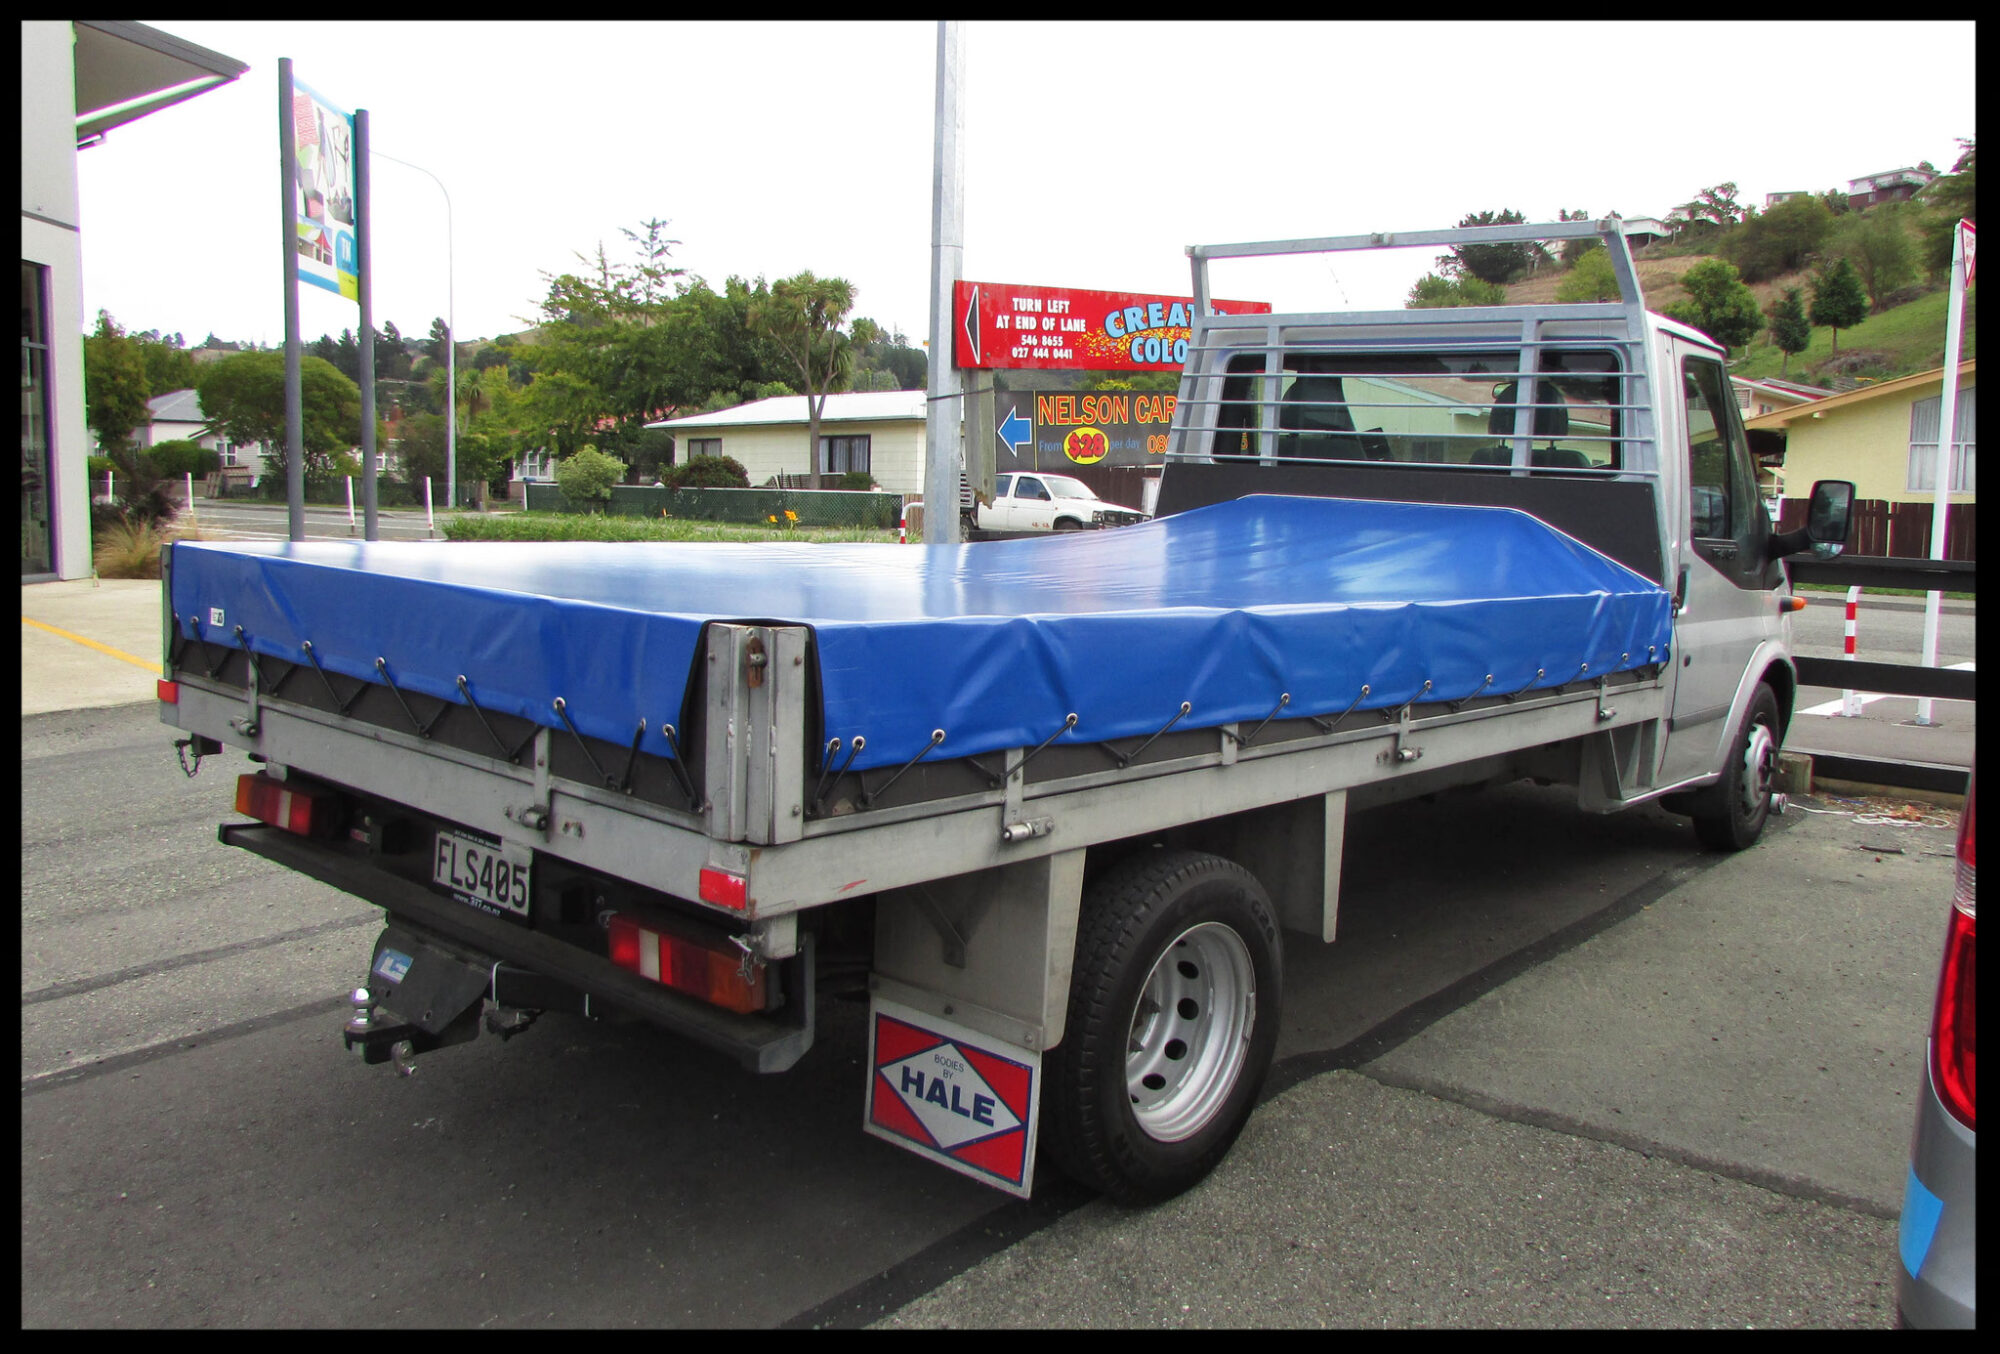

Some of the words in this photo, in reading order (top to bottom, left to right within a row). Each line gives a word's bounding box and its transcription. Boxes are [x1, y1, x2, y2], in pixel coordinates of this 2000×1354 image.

[1012, 297, 1042, 313] TURN
[1047, 299, 1070, 314] LEFT
[996, 314, 1010, 329] AT
[1015, 315, 1037, 330] END
[1042, 317, 1056, 331] OF
[1060, 318, 1086, 332] LANE
[1104, 302, 1228, 338] CREA
[1021, 334, 1038, 346] 546
[1041, 335, 1064, 347] 8655
[1130, 336, 1189, 364] COLO
[1011, 347, 1030, 358] 027
[1032, 347, 1050, 359] 444
[1038, 395, 1129, 426] NELSON
[1038, 440, 1063, 453] From
[1068, 432, 1106, 460] $28
[1109, 441, 1124, 452] per
[1126, 437, 1141, 451] day
[437, 837, 528, 909] FLS405
[934, 1053, 965, 1073] BODIES
[942, 1068, 954, 1080] BY
[901, 1064, 996, 1128] HALE
